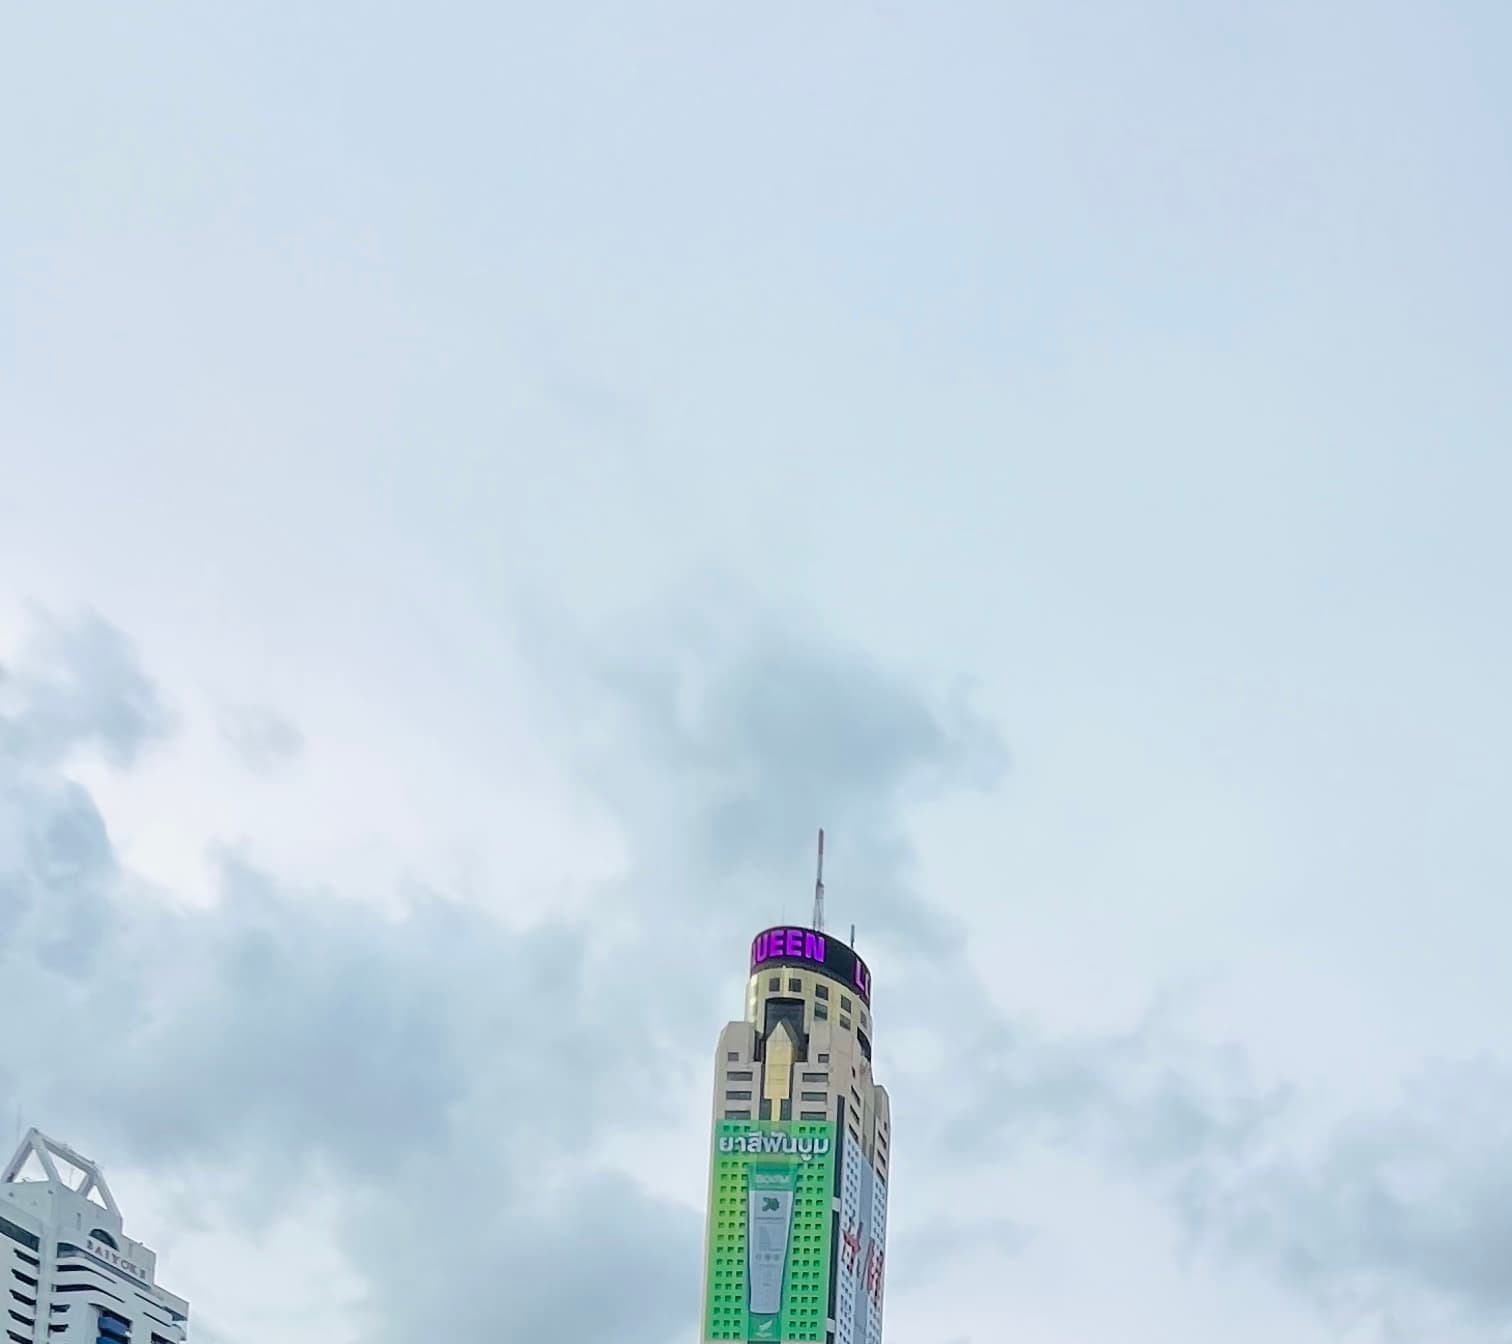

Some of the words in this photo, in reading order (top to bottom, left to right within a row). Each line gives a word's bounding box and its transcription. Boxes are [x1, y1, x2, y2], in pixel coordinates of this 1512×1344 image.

[752, 929, 825, 966] UEEN
[719, 1130, 830, 1161] ยาสีฟันบูม
